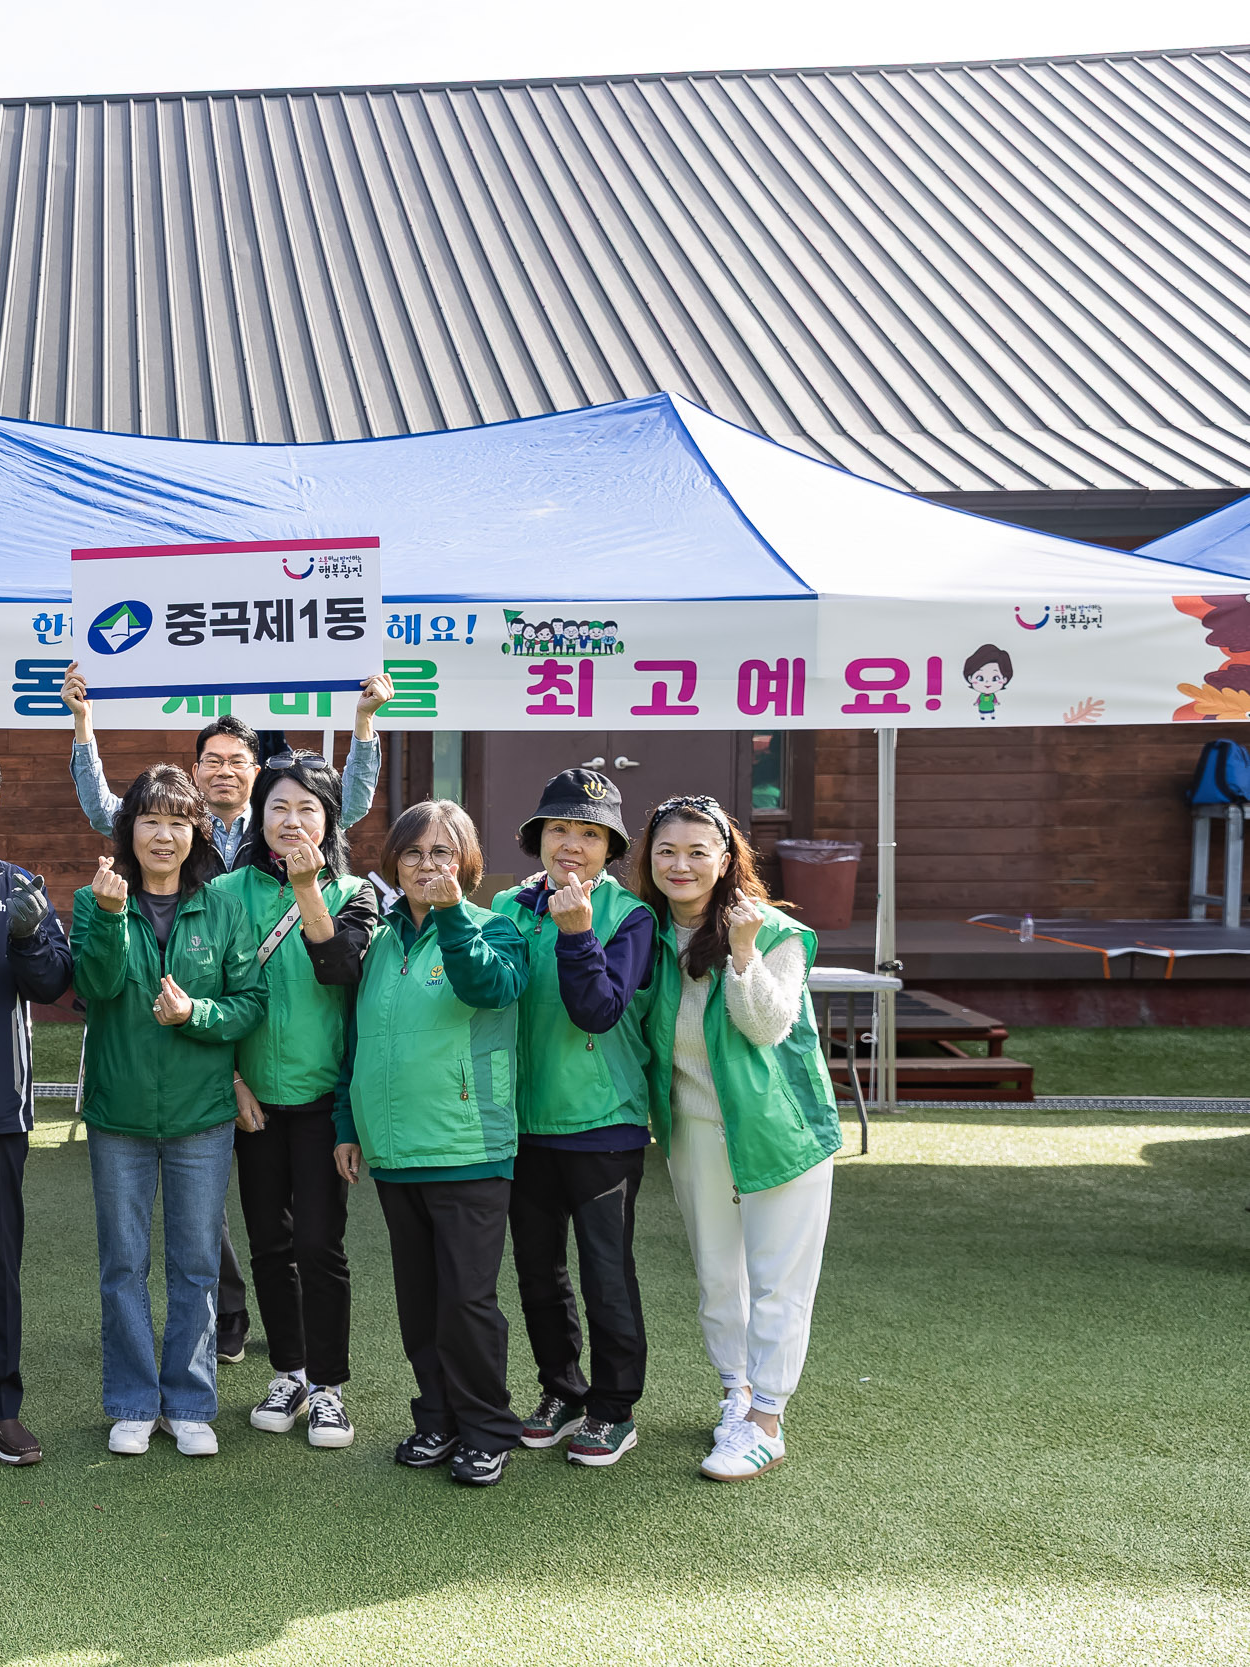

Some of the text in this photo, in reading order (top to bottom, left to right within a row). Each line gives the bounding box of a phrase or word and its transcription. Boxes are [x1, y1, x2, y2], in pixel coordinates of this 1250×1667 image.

[319, 563, 362, 579] 행복광진
[165, 597, 367, 646] 중곡제1동
[385, 613, 477, 645] 해요!
[1054, 613, 1102, 630] 행복광진
[526, 655, 942, 718] 최고예요!
[425, 978, 444, 987] SMU
